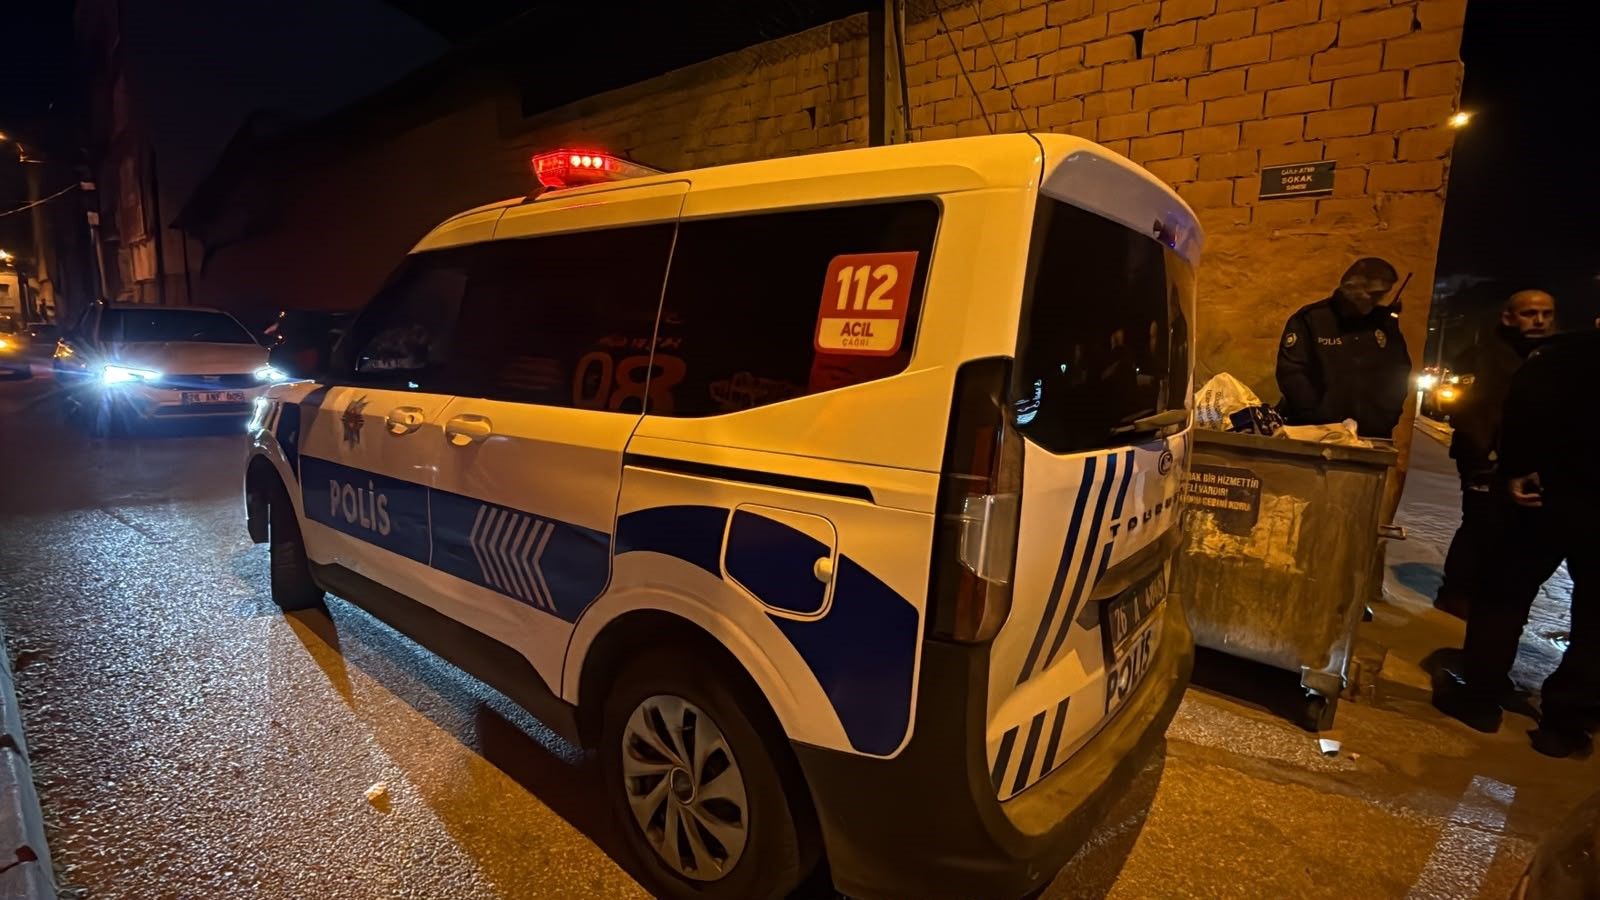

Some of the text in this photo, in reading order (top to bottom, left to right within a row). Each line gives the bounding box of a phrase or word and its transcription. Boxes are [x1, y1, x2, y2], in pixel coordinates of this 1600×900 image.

[1281, 175, 1312, 185] SOKAK
[836, 264, 898, 311] 112
[329, 479, 391, 536] POLİS
